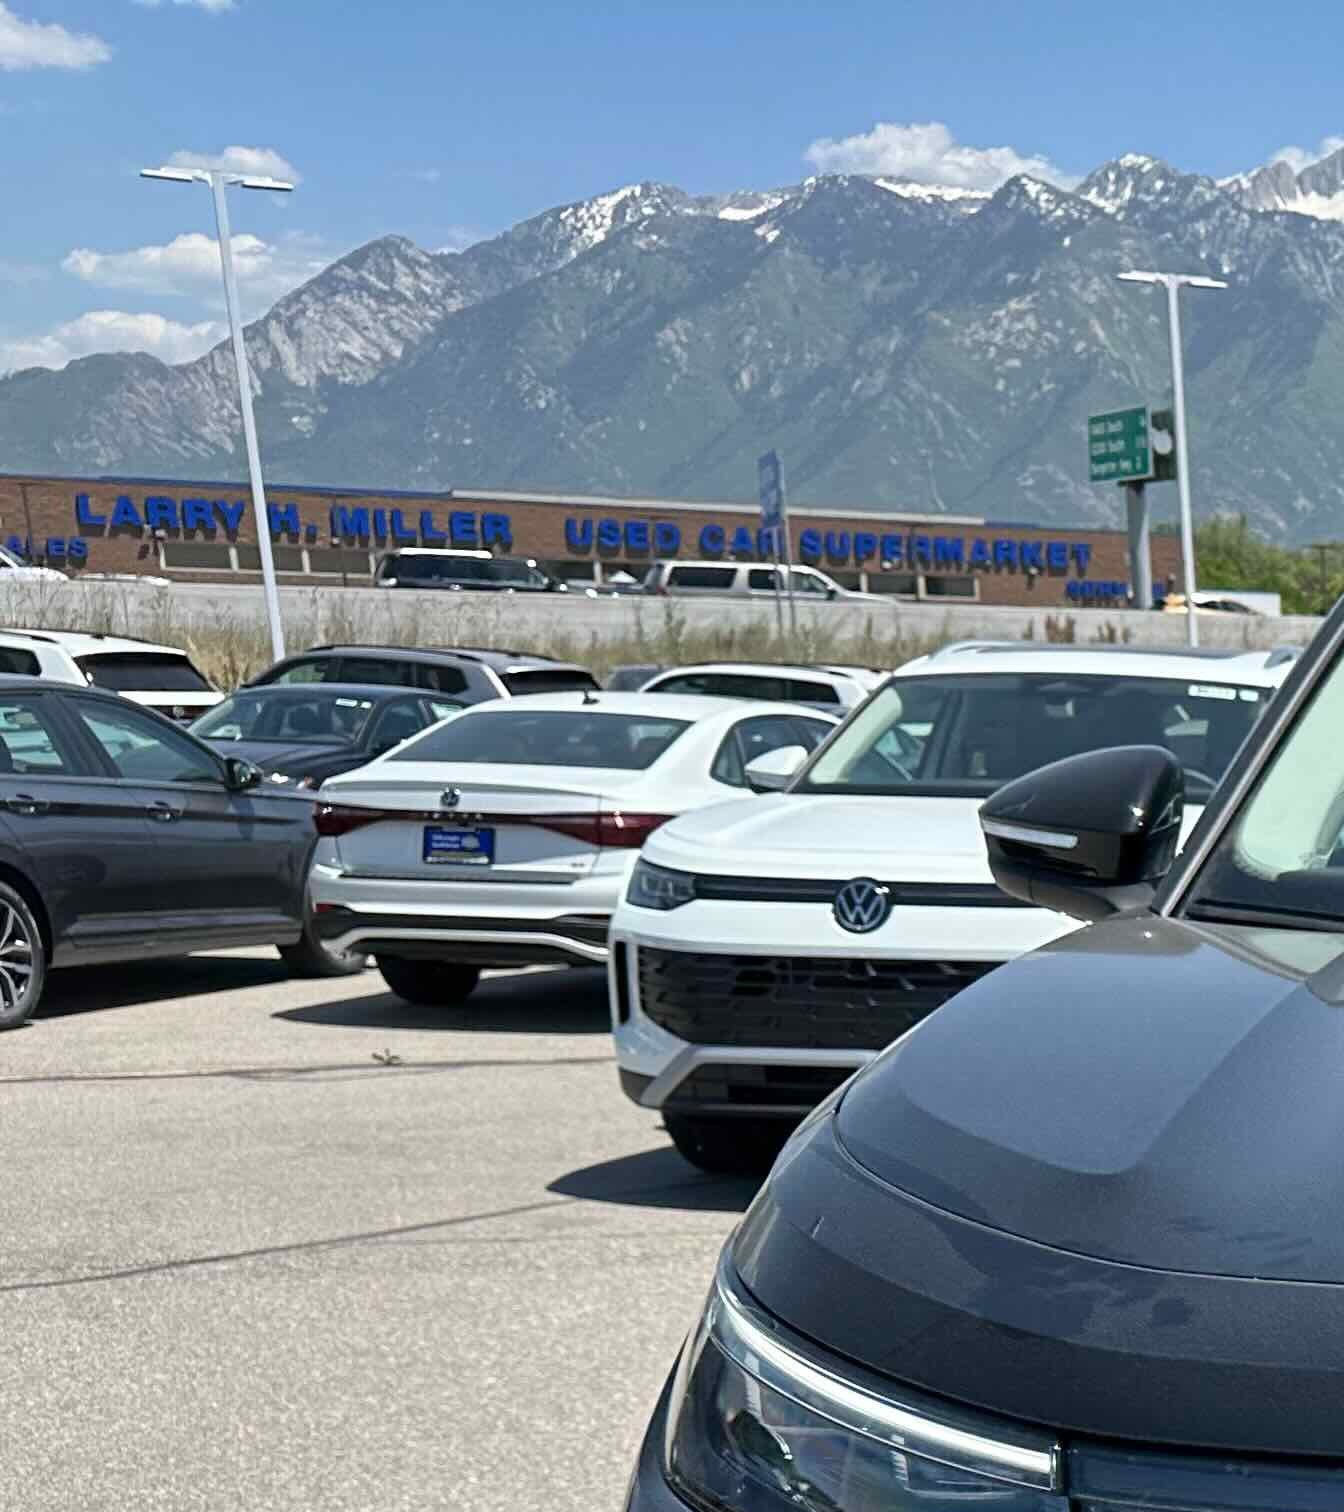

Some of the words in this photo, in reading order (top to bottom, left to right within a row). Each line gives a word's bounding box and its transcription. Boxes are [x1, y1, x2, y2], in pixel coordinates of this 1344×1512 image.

[76, 492, 245, 530] LARRY
[267, 503, 317, 535] H.
[331, 504, 513, 546] MILLER
[564, 517, 682, 550] USED
[698, 523, 785, 558] CAR
[799, 527, 1092, 574] SUPERMARKET
